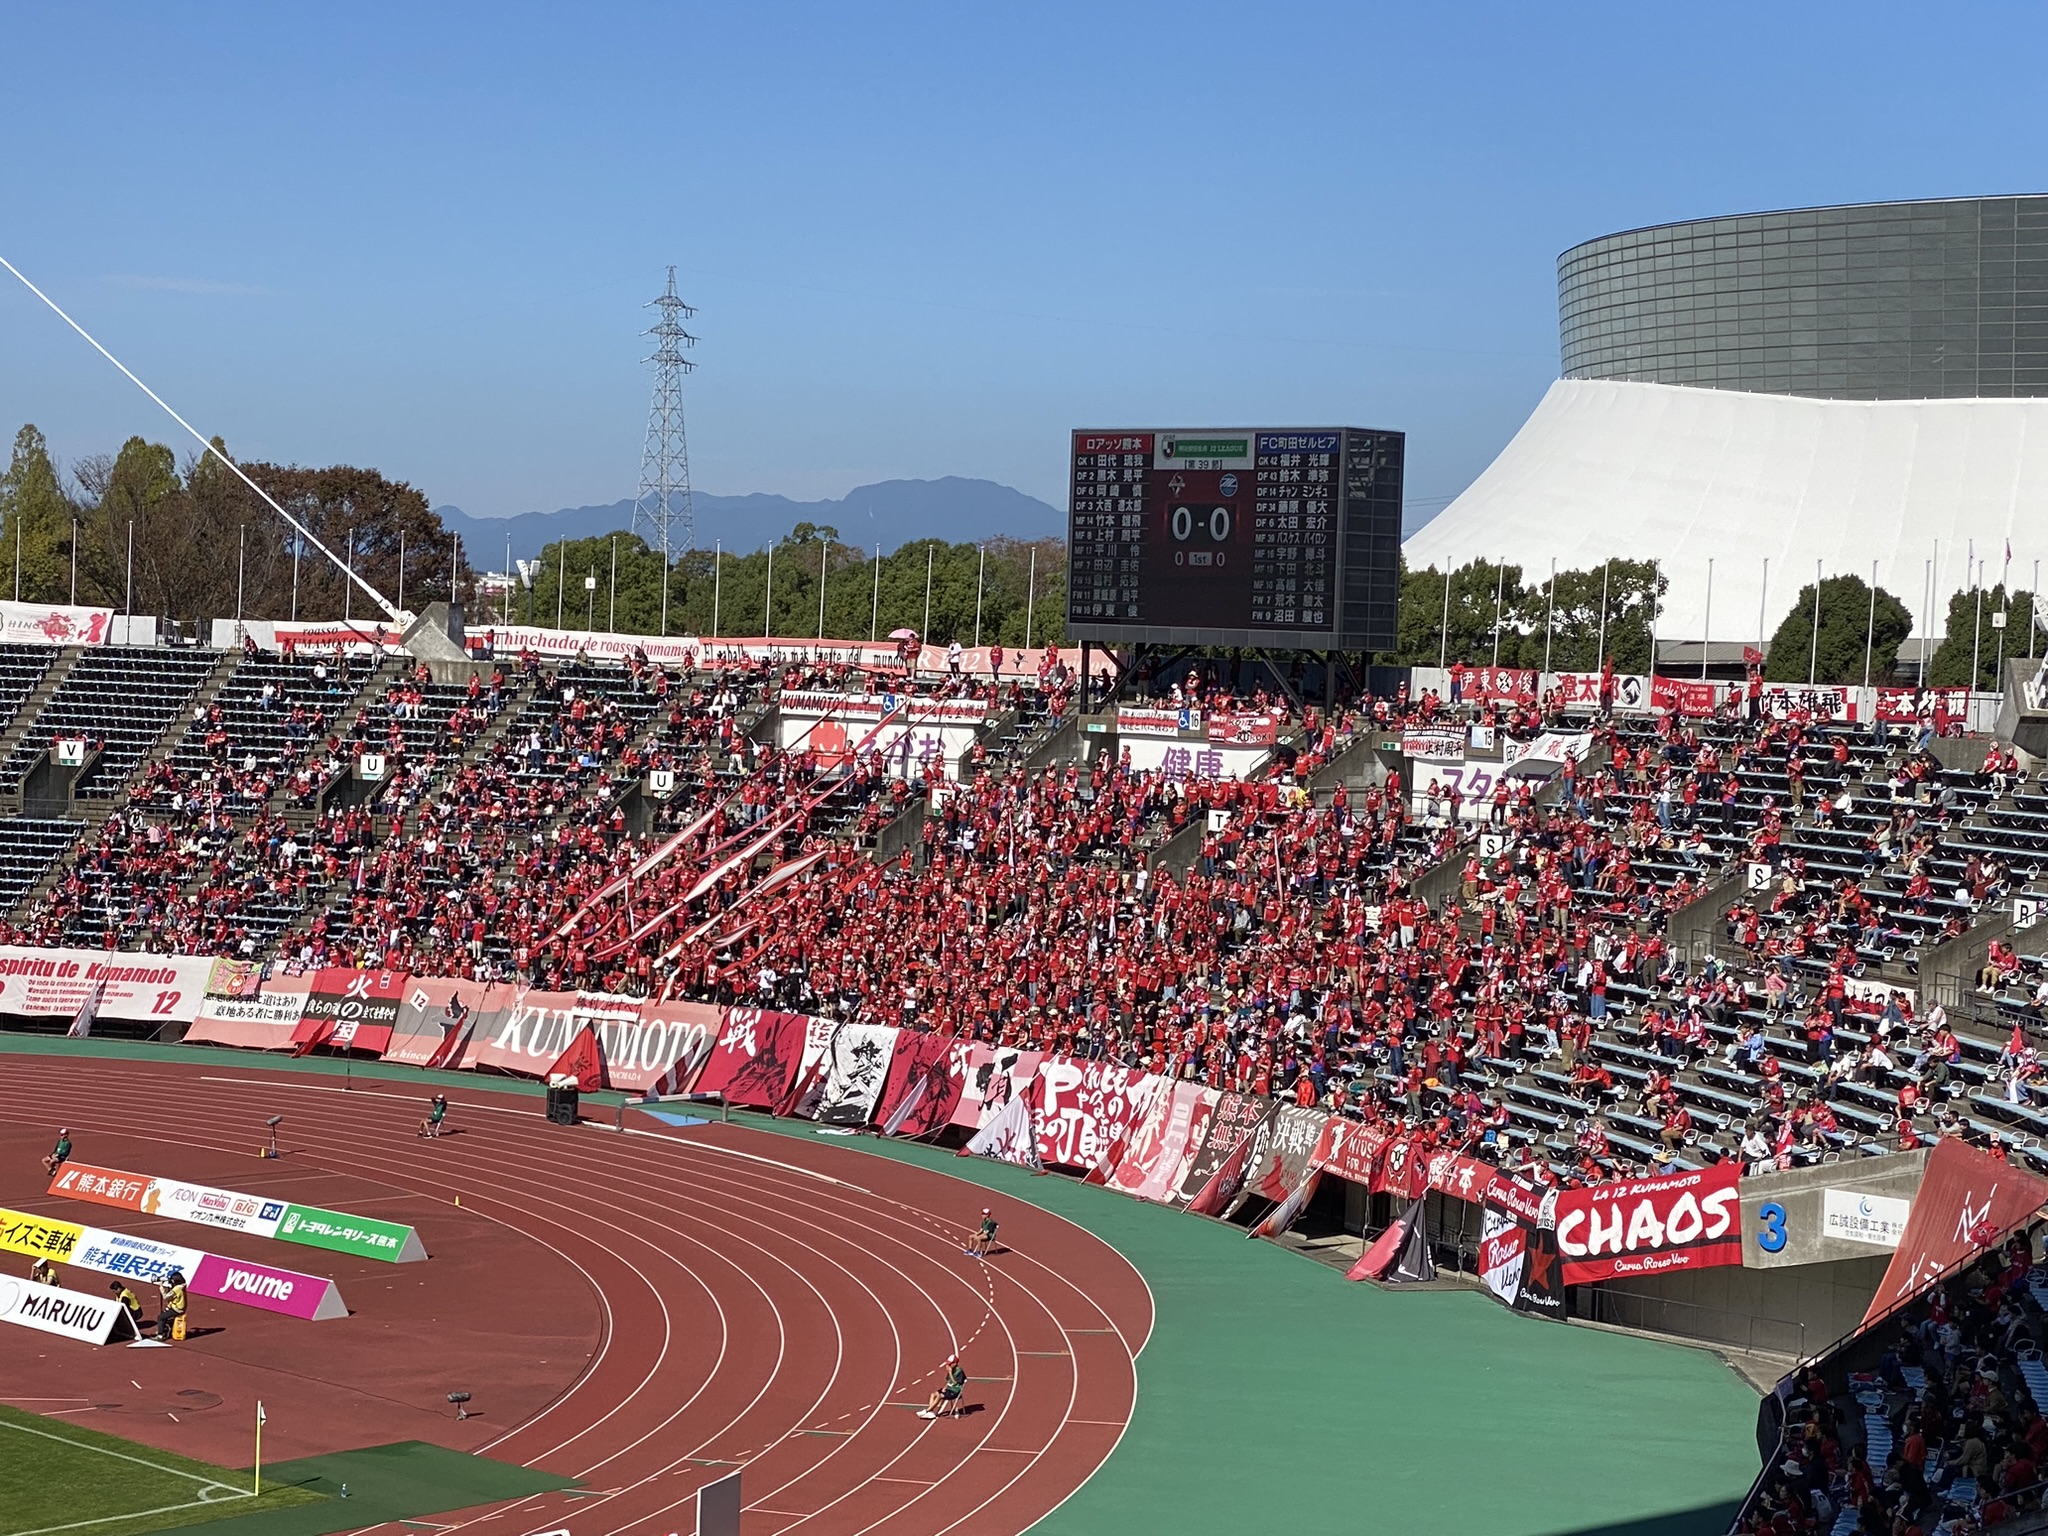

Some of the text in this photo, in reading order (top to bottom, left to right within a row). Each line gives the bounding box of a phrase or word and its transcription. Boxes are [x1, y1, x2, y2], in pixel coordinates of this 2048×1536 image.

[1086, 437, 1143, 450] ロアッソ熊本
[1260, 436, 1337, 450] FC町田ゼルビア
[1097, 454, 1117, 467] 田代
[1278, 485, 1298, 498] チャン
[1096, 514, 1115, 527] 竹本
[1172, 506, 1230, 541] 0 0
[1277, 516, 1298, 530] 太田
[1095, 529, 1115, 542] 上村
[1094, 544, 1117, 557] 平川
[1175, 551, 1225, 567] 0 1st 0
[302, 626, 339, 637] roasso
[285, 637, 358, 650] UMAMOTO
[504, 631, 580, 652] hinchada
[582, 636, 598, 652] de
[600, 639, 637, 654] roasso
[638, 640, 700, 658] kumamoto
[1460, 668, 1492, 693] 伊東
[1191, 713, 1199, 728] 16
[1484, 727, 1493, 747] 15
[66, 743, 77, 757] V
[367, 758, 377, 772] U
[1161, 745, 1224, 785] 健康
[657, 774, 667, 788] U
[1215, 814, 1224, 829] T
[1486, 838, 1495, 855] S
[1754, 867, 1764, 886] S
[2020, 904, 2029, 925] R
[56, 959, 80, 979] de
[85, 962, 178, 985] Kumamoto
[151, 990, 182, 1015] 12
[413, 993, 426, 1008] 12
[719, 1007, 762, 1057] 戦
[1216, 1091, 1264, 1126] 熊本
[1271, 1114, 1321, 1157] 決戦熊
[75, 1172, 143, 1202] 熊本銀行
[1592, 1174, 1702, 1202] LA 12 KUMAMOTO
[235, 1200, 256, 1215] BIG
[189, 1210, 247, 1229] イオン九州株式会社
[1557, 1186, 1740, 1257] CHAOS
[1757, 1201, 1787, 1253] 3
[1829, 1213, 1890, 1235] 広誠設備工業
[4, 1221, 77, 1256] イズミ車体
[297, 1219, 399, 1249] トヨタレンタリース熊本
[1488, 1238, 1520, 1269] Rosso
[1614, 1251, 1690, 1273] Curva Rosso Vero
[218, 1267, 294, 1301] youme
[1501, 1265, 1521, 1291] Vero
[20, 1292, 106, 1332] MARUKU
